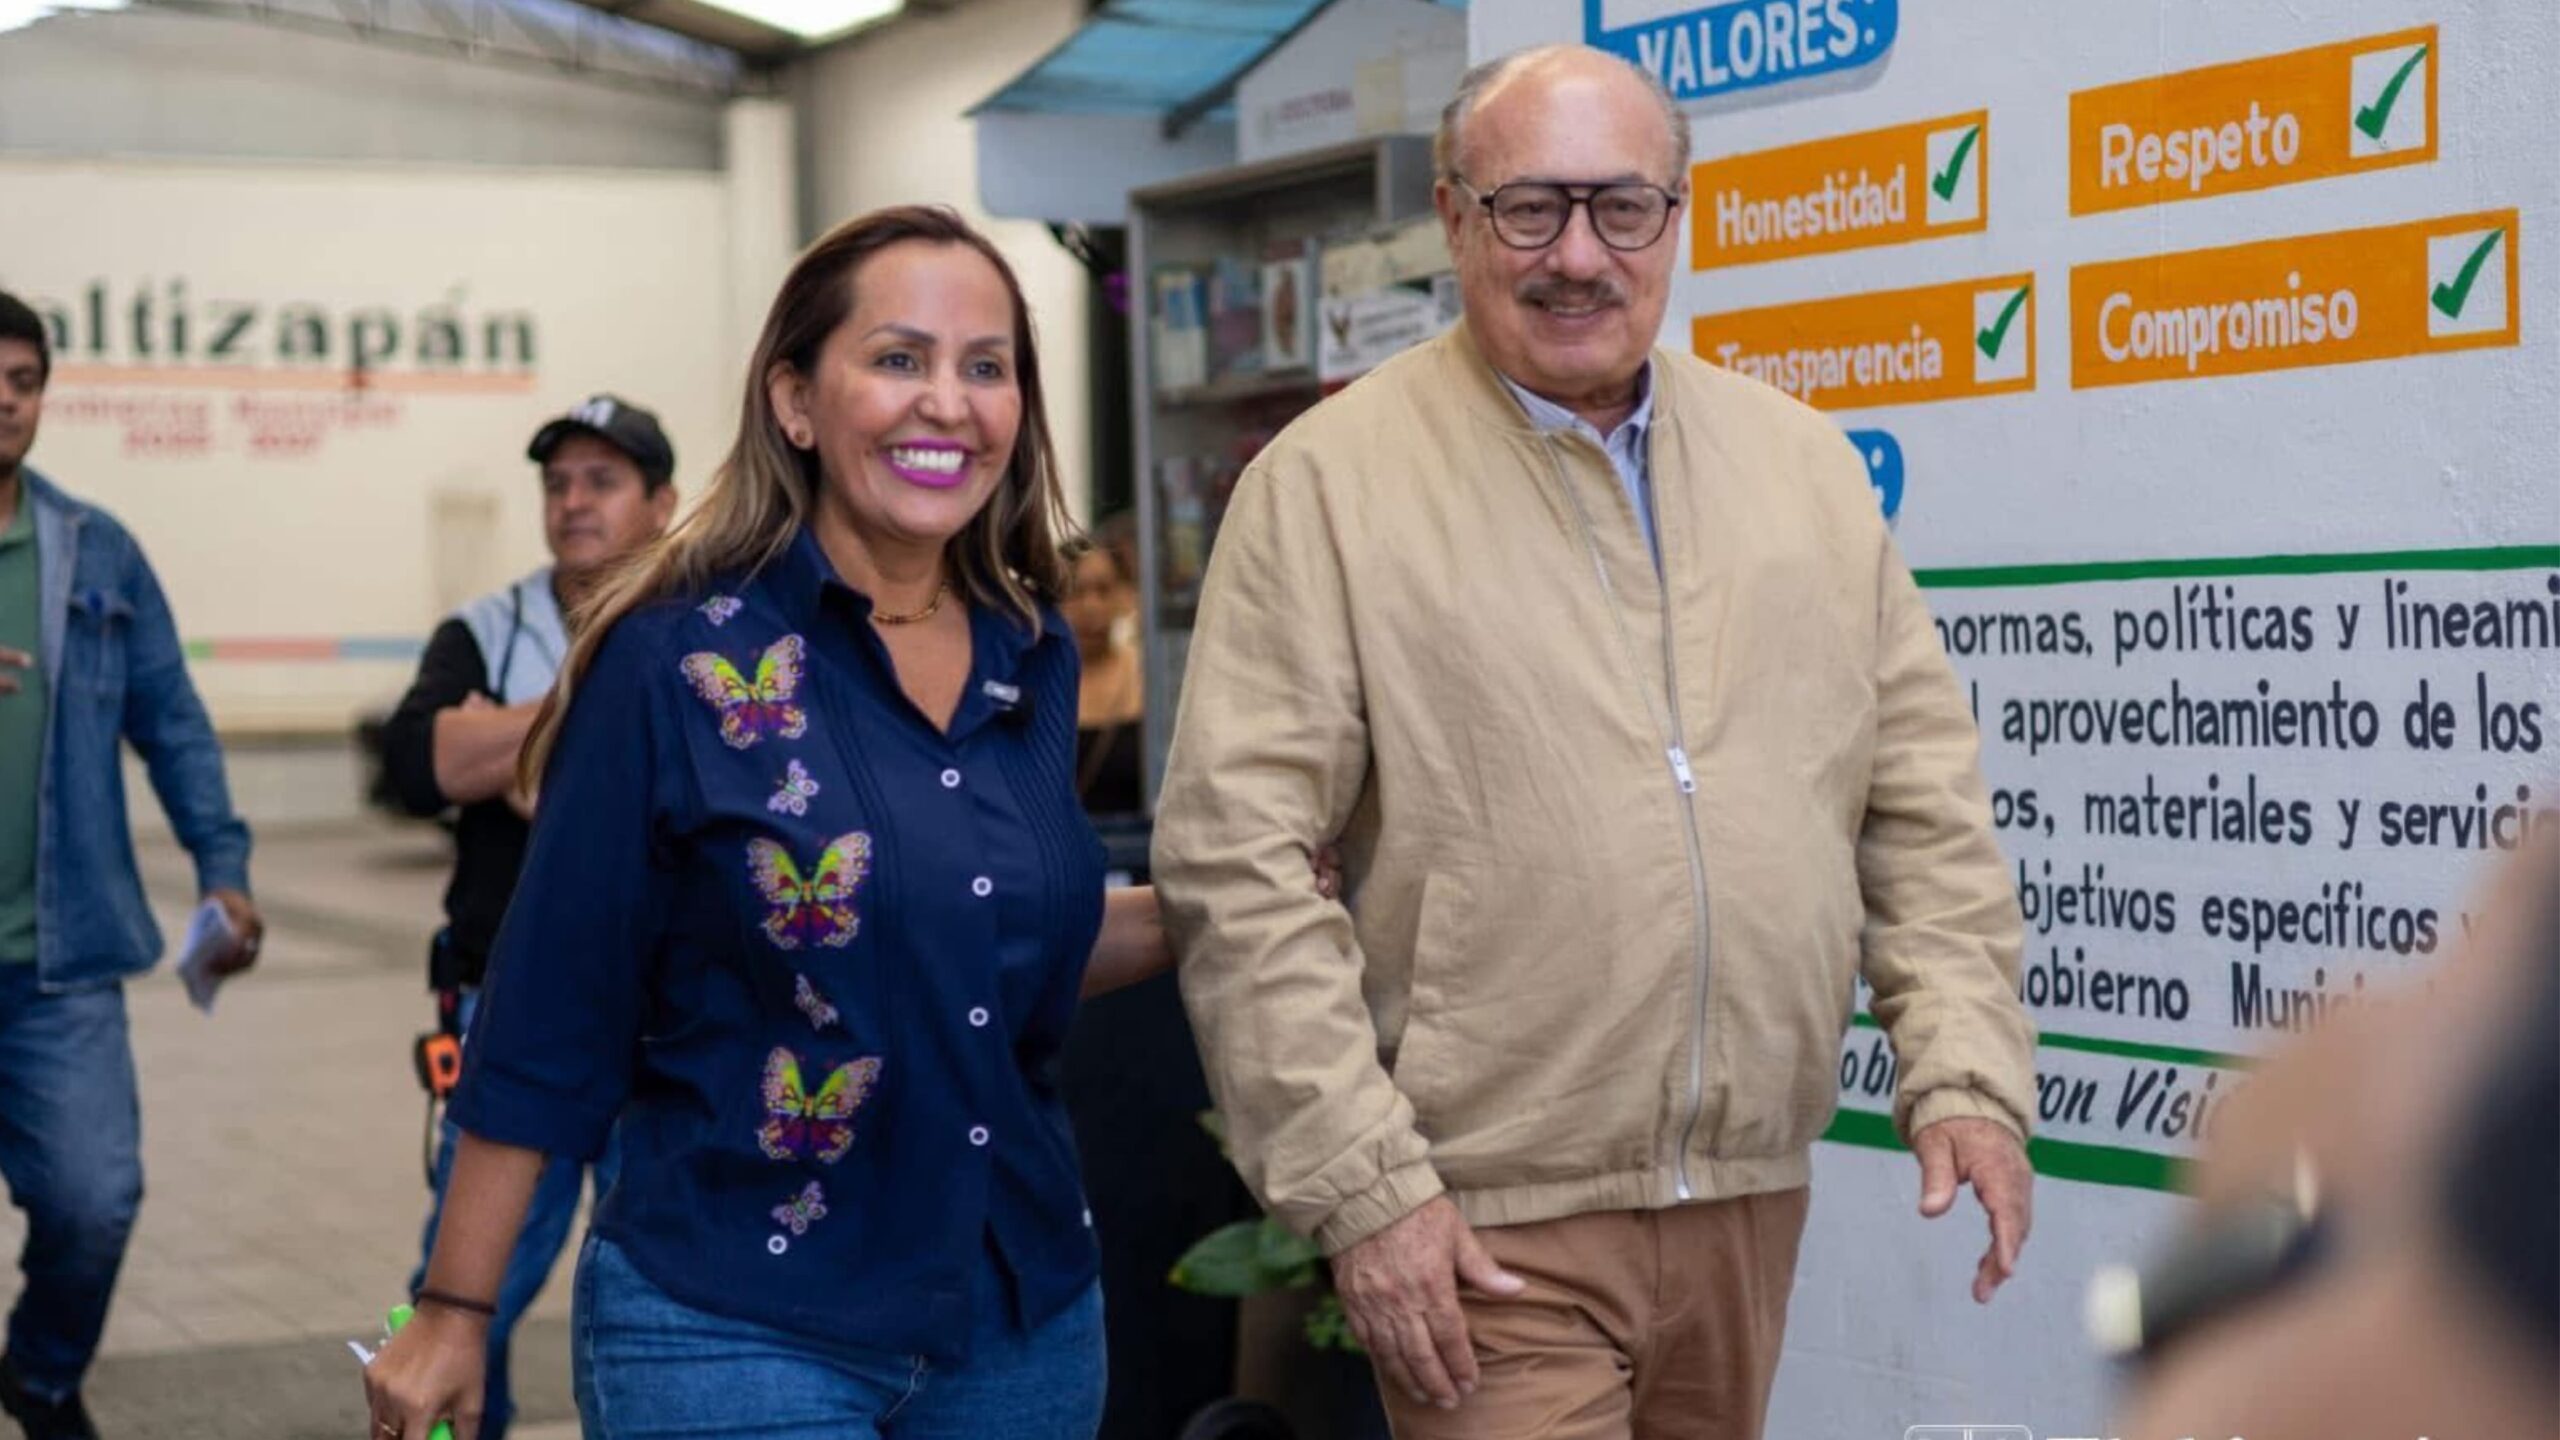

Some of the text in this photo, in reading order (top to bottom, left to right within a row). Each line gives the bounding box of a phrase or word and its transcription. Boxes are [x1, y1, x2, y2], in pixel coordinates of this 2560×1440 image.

[2101, 101, 2299, 191] Respeto
[1717, 164, 1907, 248] Honestidad
[2099, 271, 2358, 372] Compromiso
[2114, 584, 2314, 667] políticas
[2337, 604, 2360, 650] y
[2002, 677, 2379, 756] aprovechamiento
[2403, 678, 2456, 750] de
[2476, 671, 2543, 753] los
[2085, 773, 2312, 842] materiales
[2338, 799, 2361, 851] y
[2379, 782, 2560, 850] servici
[2019, 946, 2190, 1021] obierno
